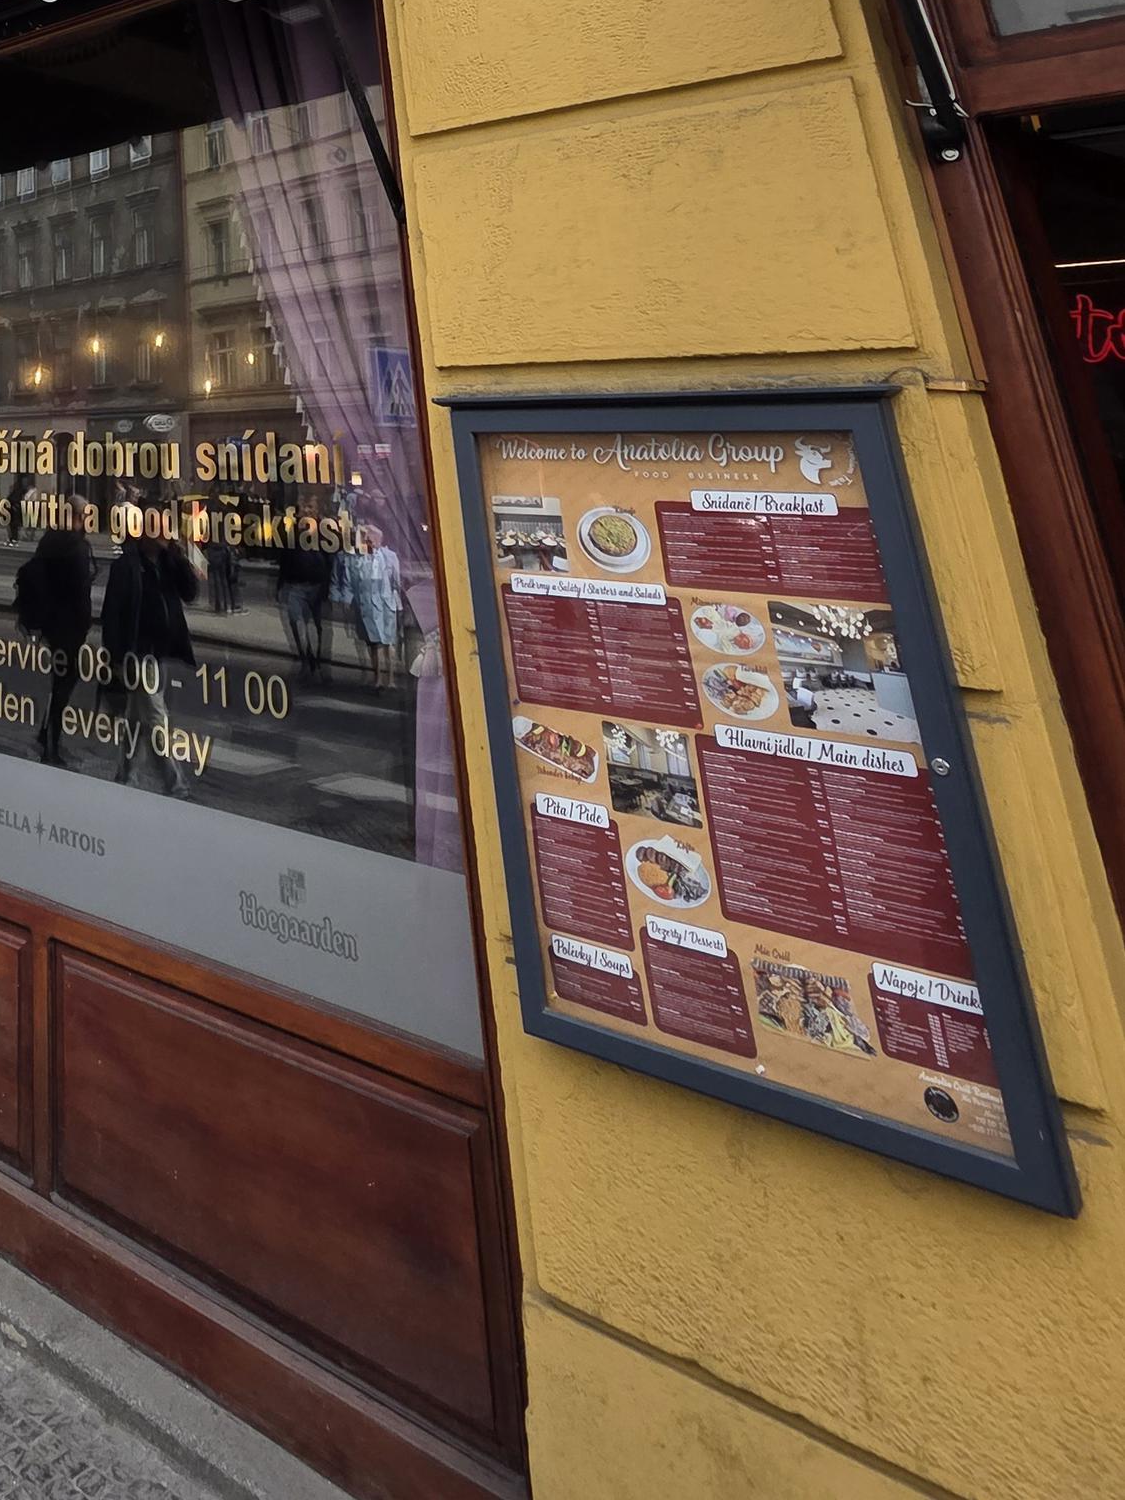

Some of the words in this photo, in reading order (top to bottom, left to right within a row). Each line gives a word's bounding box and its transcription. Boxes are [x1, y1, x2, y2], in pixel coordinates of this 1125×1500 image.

[67, 430, 180, 480] dobrou
[496, 438, 567, 461] Welcome
[571, 443, 588, 460] to
[592, 433, 704, 471] Anatolia
[708, 433, 784, 473] Group
[634, 471, 669, 479] FOOD
[687, 472, 760, 481] BUSINESS
[21, 491, 73, 532] with
[83, 503, 100, 534] a
[111, 500, 179, 545] good
[702, 493, 751, 512] Snídaně
[760, 494, 825, 515] Breakfast
[586, 583, 617, 597] Starters
[618, 586, 633, 597] and
[634, 587, 662, 600] Salads
[78, 643, 112, 685] 08
[123, 651, 160, 695] 00
[195, 662, 227, 708] 11
[244, 671, 289, 719] 00
[61, 704, 141, 760] every
[151, 716, 212, 777] day
[724, 727, 772, 751] Hlavní
[773, 737, 805, 758] jídla
[816, 743, 860, 767] Main
[862, 749, 906, 773] dishes
[543, 797, 567, 816] Pita
[576, 803, 604, 825] Pide
[48, 824, 106, 858] ARTOIS
[239, 890, 359, 962] Hoegaarden
[688, 931, 724, 951] Desserts
[600, 952, 630, 977] Soups
[879, 969, 926, 998] Nápoje
